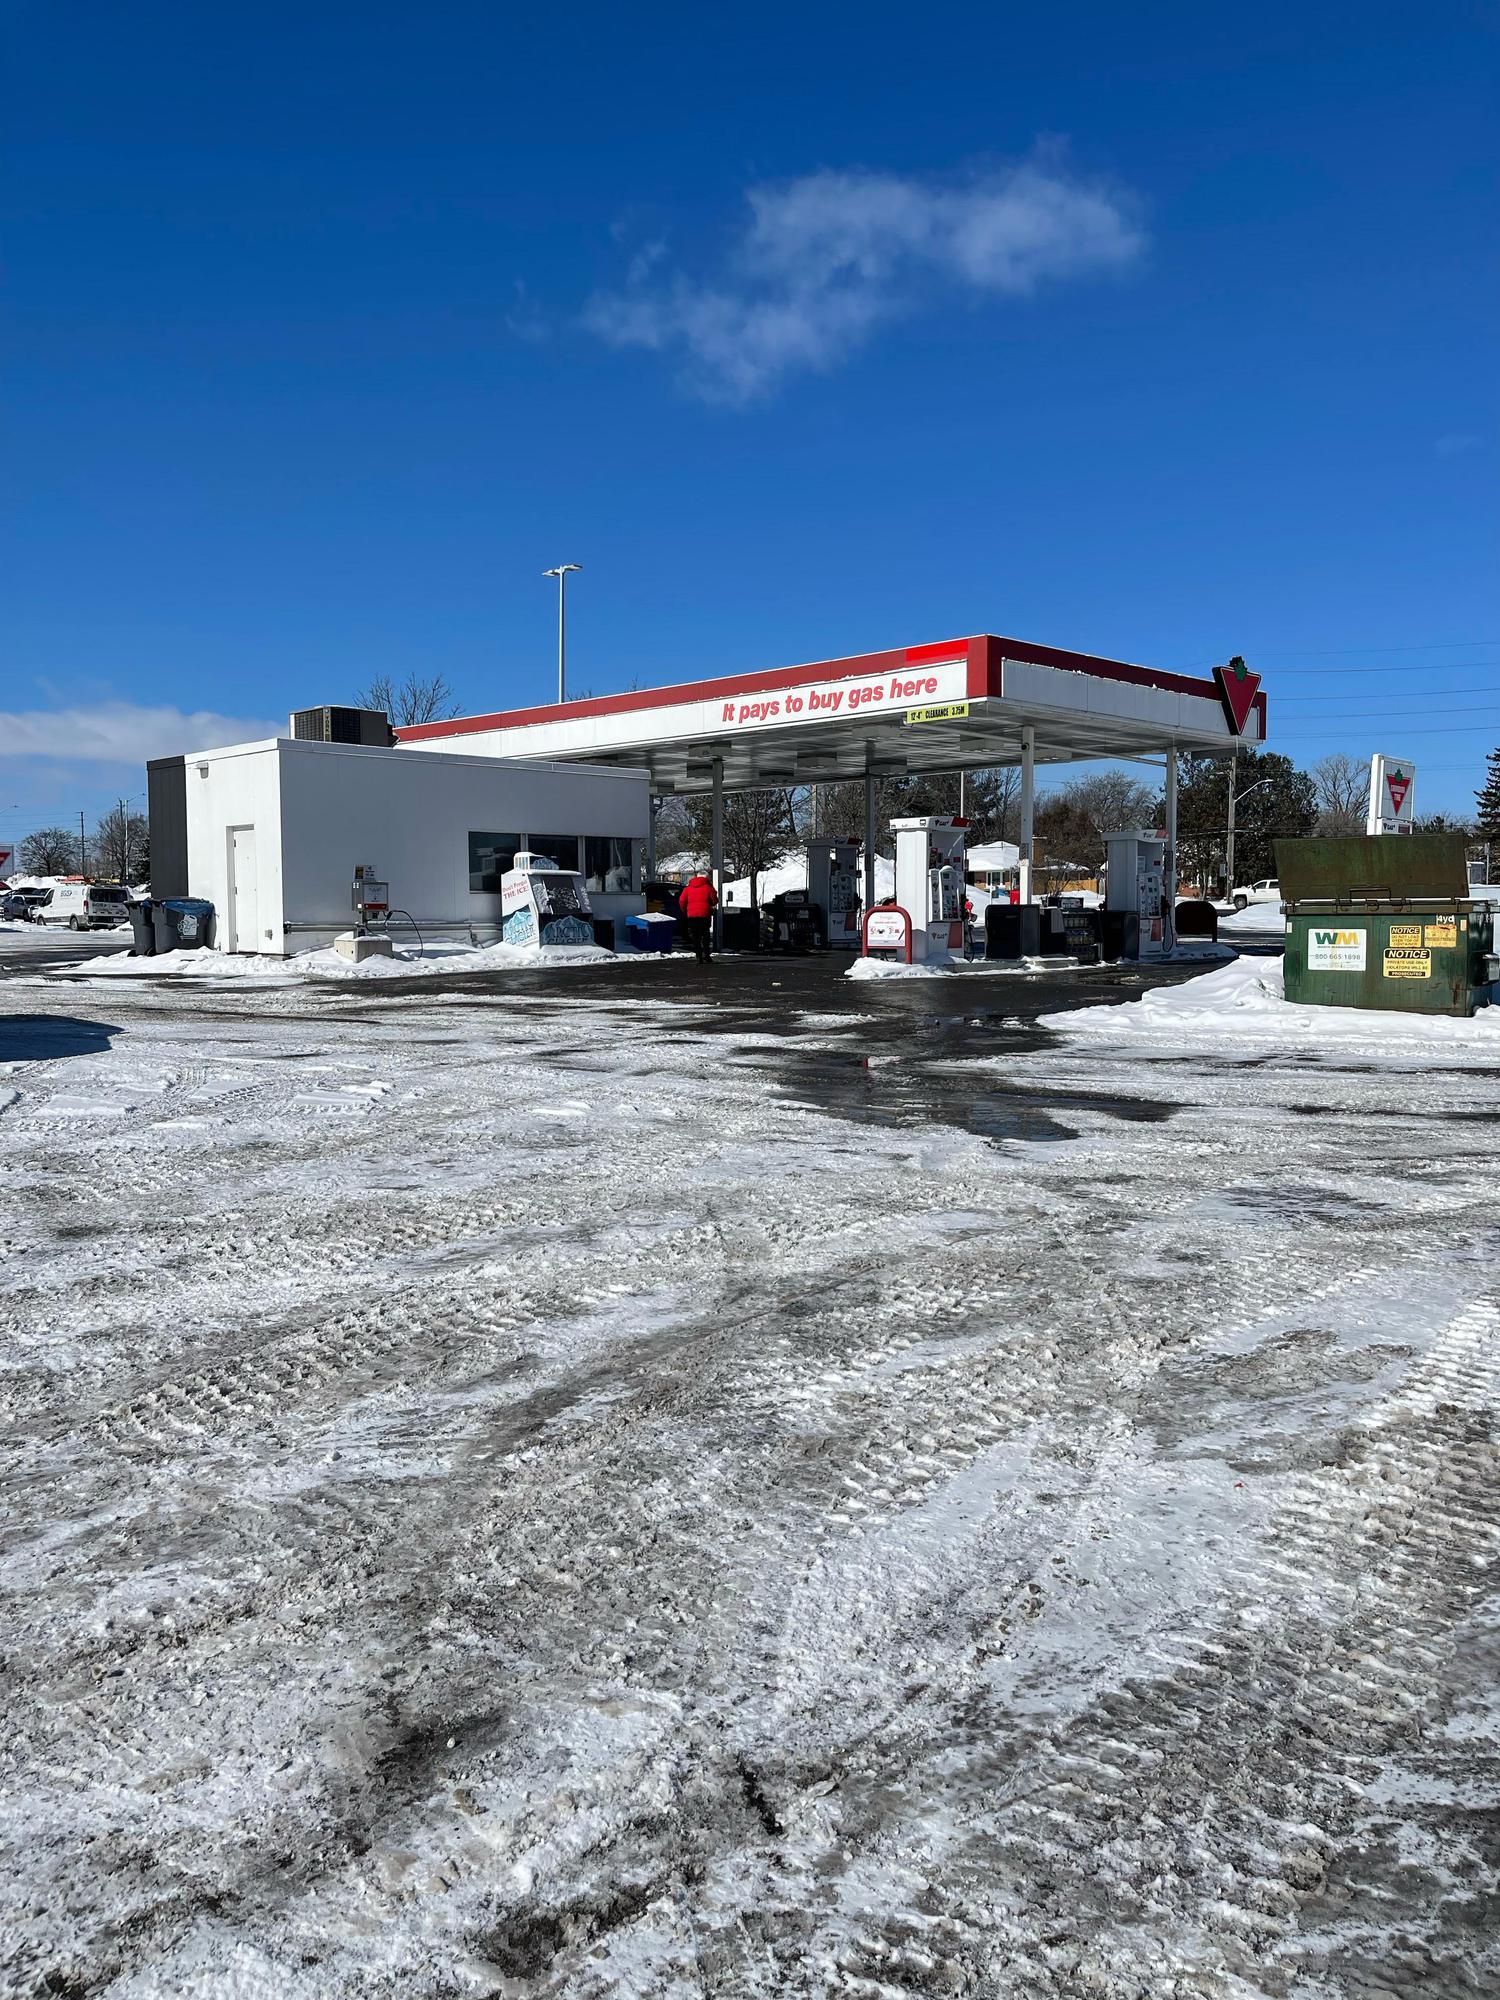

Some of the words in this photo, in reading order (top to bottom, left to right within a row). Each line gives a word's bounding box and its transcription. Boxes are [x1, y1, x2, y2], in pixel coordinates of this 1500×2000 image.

[722, 703, 735, 722] It
[739, 700, 780, 723] pays
[785, 695, 803, 713] to
[808, 690, 844, 711] buy
[848, 685, 884, 709] gas
[890, 677, 938, 698] here
[925, 708, 949, 719] CLEARANCE
[503, 890, 517, 899] THE
[1314, 932, 1360, 945] WM
[1388, 950, 1428, 958] NOTICE
